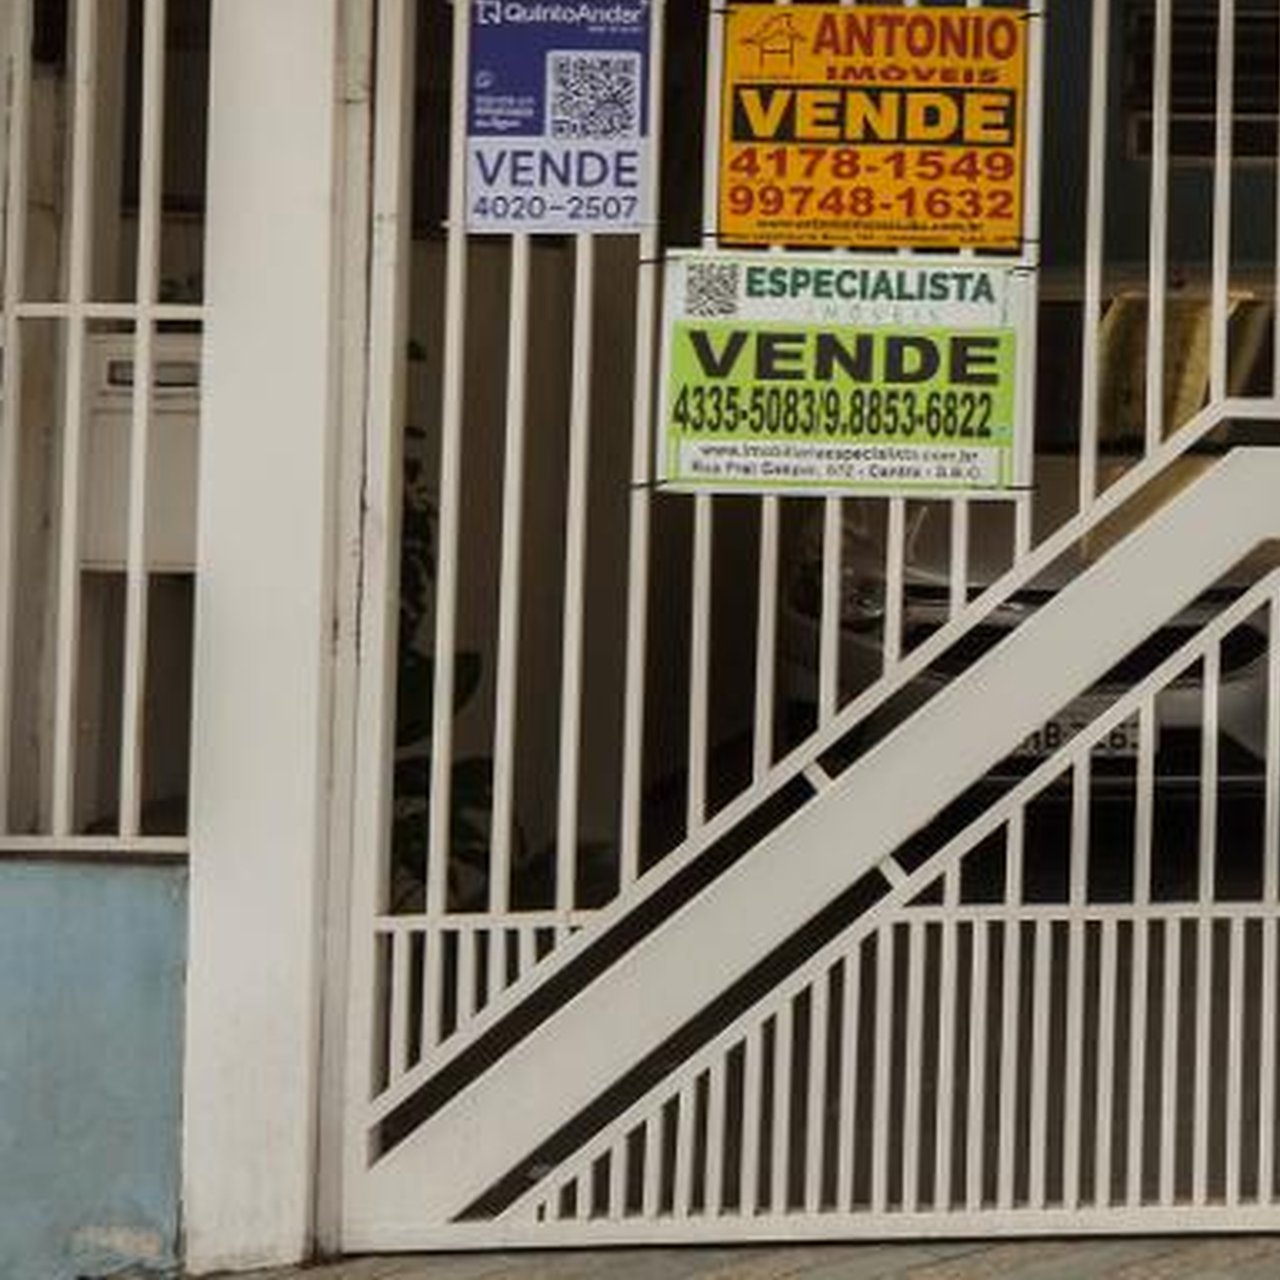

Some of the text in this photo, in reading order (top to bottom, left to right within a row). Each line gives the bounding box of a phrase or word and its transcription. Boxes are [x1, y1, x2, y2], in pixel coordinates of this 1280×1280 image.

[504, 3, 642, 24] QuintoAndar
[812, 13, 1018, 60] ANTONIO
[739, 89, 1012, 143] VENDE
[475, 150, 638, 188] VENDE
[729, 147, 1015, 181] 4178-1549
[474, 196, 638, 220] 4020-2507
[728, 185, 1014, 220] 99748-1632
[745, 266, 995, 302] ESPECIALISTA
[688, 331, 1000, 385] VENDE
